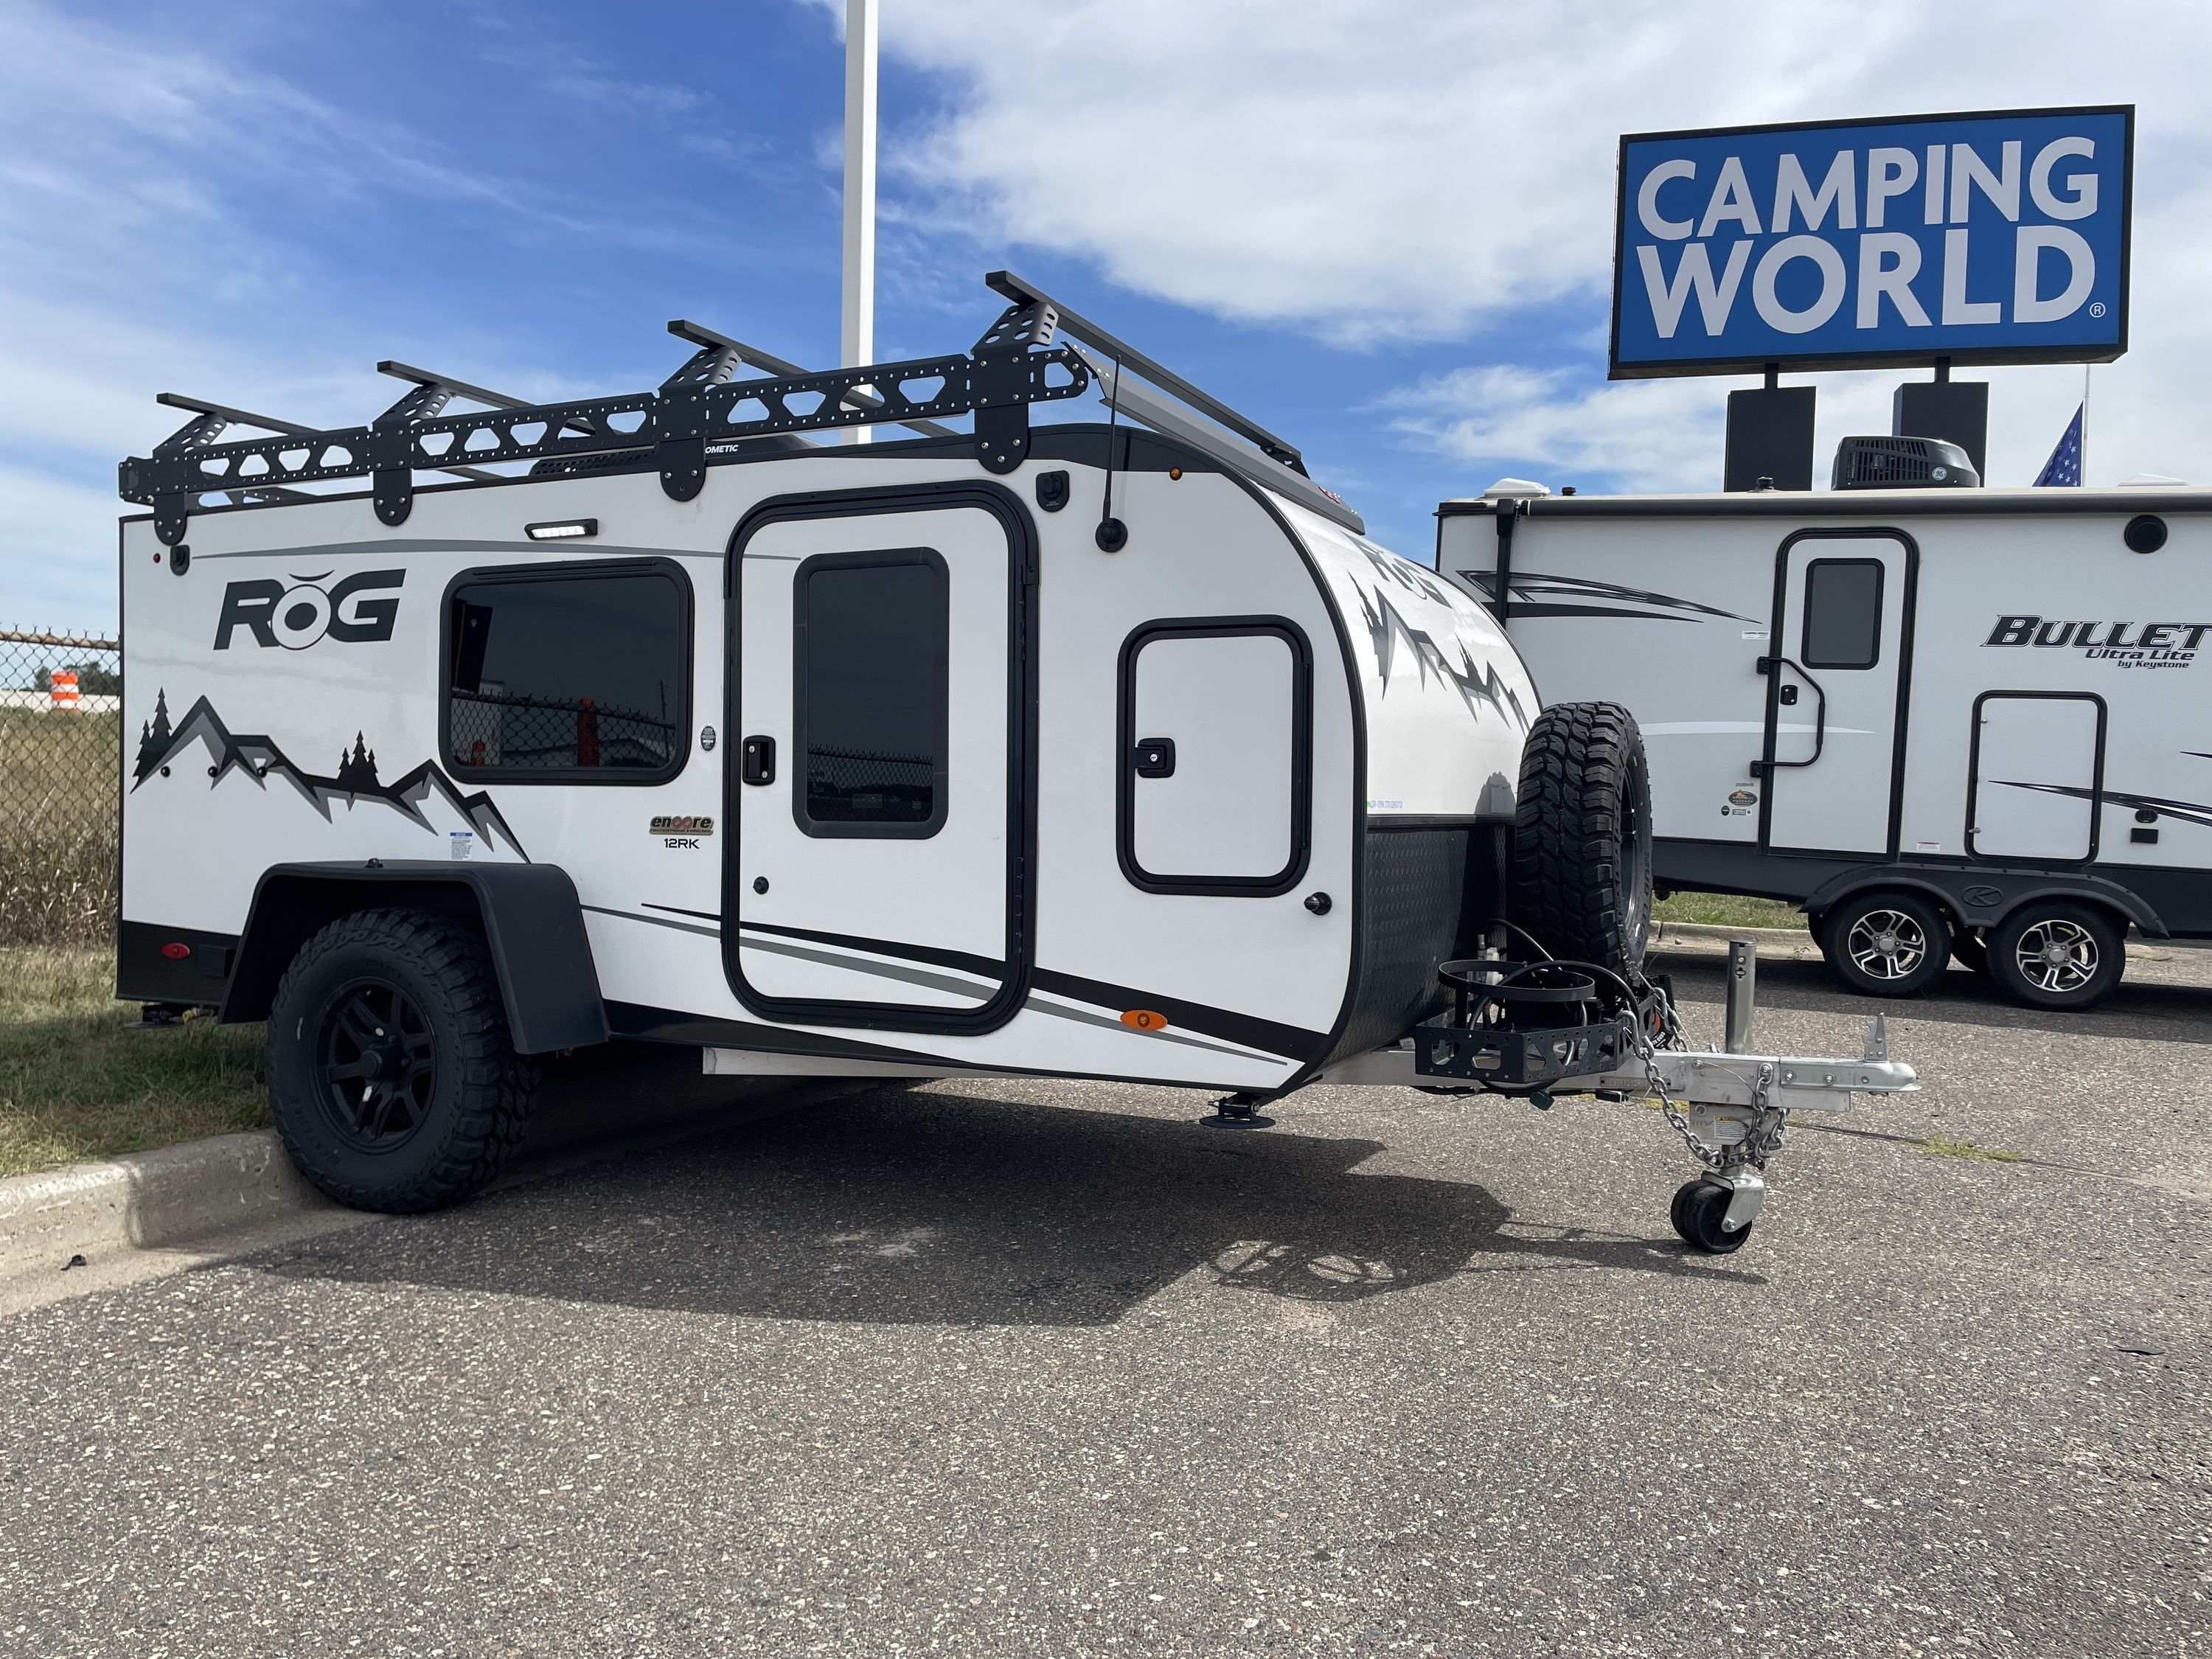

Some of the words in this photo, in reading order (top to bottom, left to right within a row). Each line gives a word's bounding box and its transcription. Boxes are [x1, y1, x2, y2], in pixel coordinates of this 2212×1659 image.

[1638, 136, 2098, 240] CAMPING
[1636, 225, 2096, 338] WORLD
[705, 445, 739, 454] OMETIC
[1980, 614, 2212, 650] BULLET
[2086, 649, 2144, 660] Ultra
[2149, 650, 2195, 661] Lite
[2118, 661, 2132, 669] by
[2135, 661, 2189, 669] Keystone
[664, 838, 700, 849] 12RK
